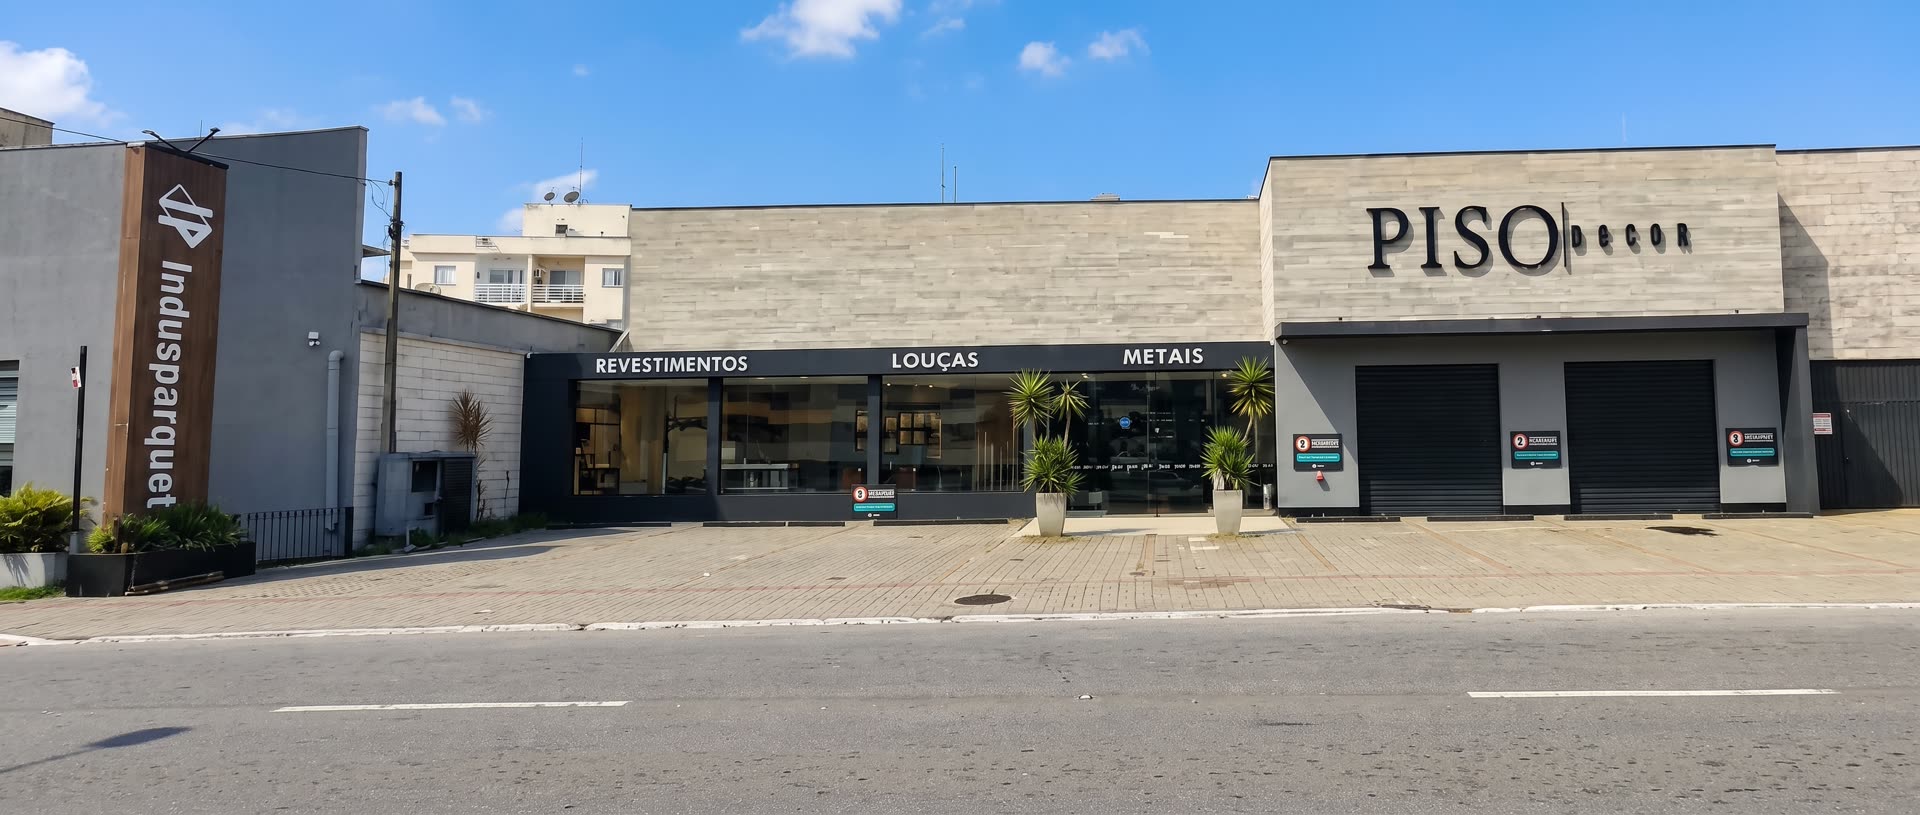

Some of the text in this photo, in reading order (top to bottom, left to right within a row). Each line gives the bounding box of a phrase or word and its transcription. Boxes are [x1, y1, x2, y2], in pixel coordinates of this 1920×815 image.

[1366, 205, 1559, 269] PISO
[595, 355, 748, 374] REVESTIMENTOS
[891, 352, 979, 372] LOUÇAS
[1123, 348, 1204, 365] METAIS
[144, 260, 193, 508] Indusparquet
